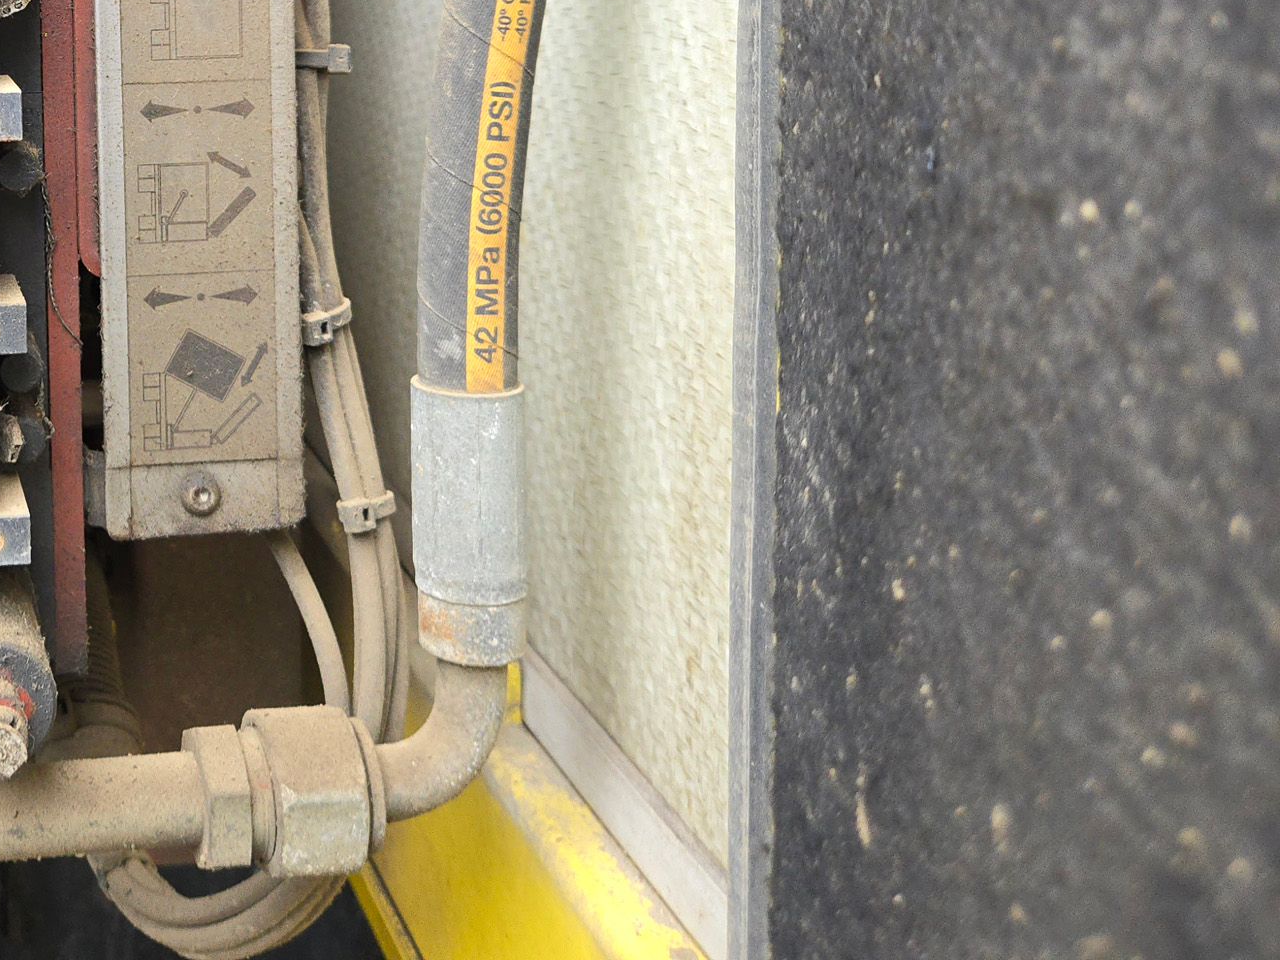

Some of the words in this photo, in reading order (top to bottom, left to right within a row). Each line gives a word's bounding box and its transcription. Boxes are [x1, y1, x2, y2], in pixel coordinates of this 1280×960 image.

[486, 81, 517, 142] PSI)
[476, 152, 508, 235] (6000
[475, 246, 501, 316] MPa
[473, 325, 498, 364] 42
